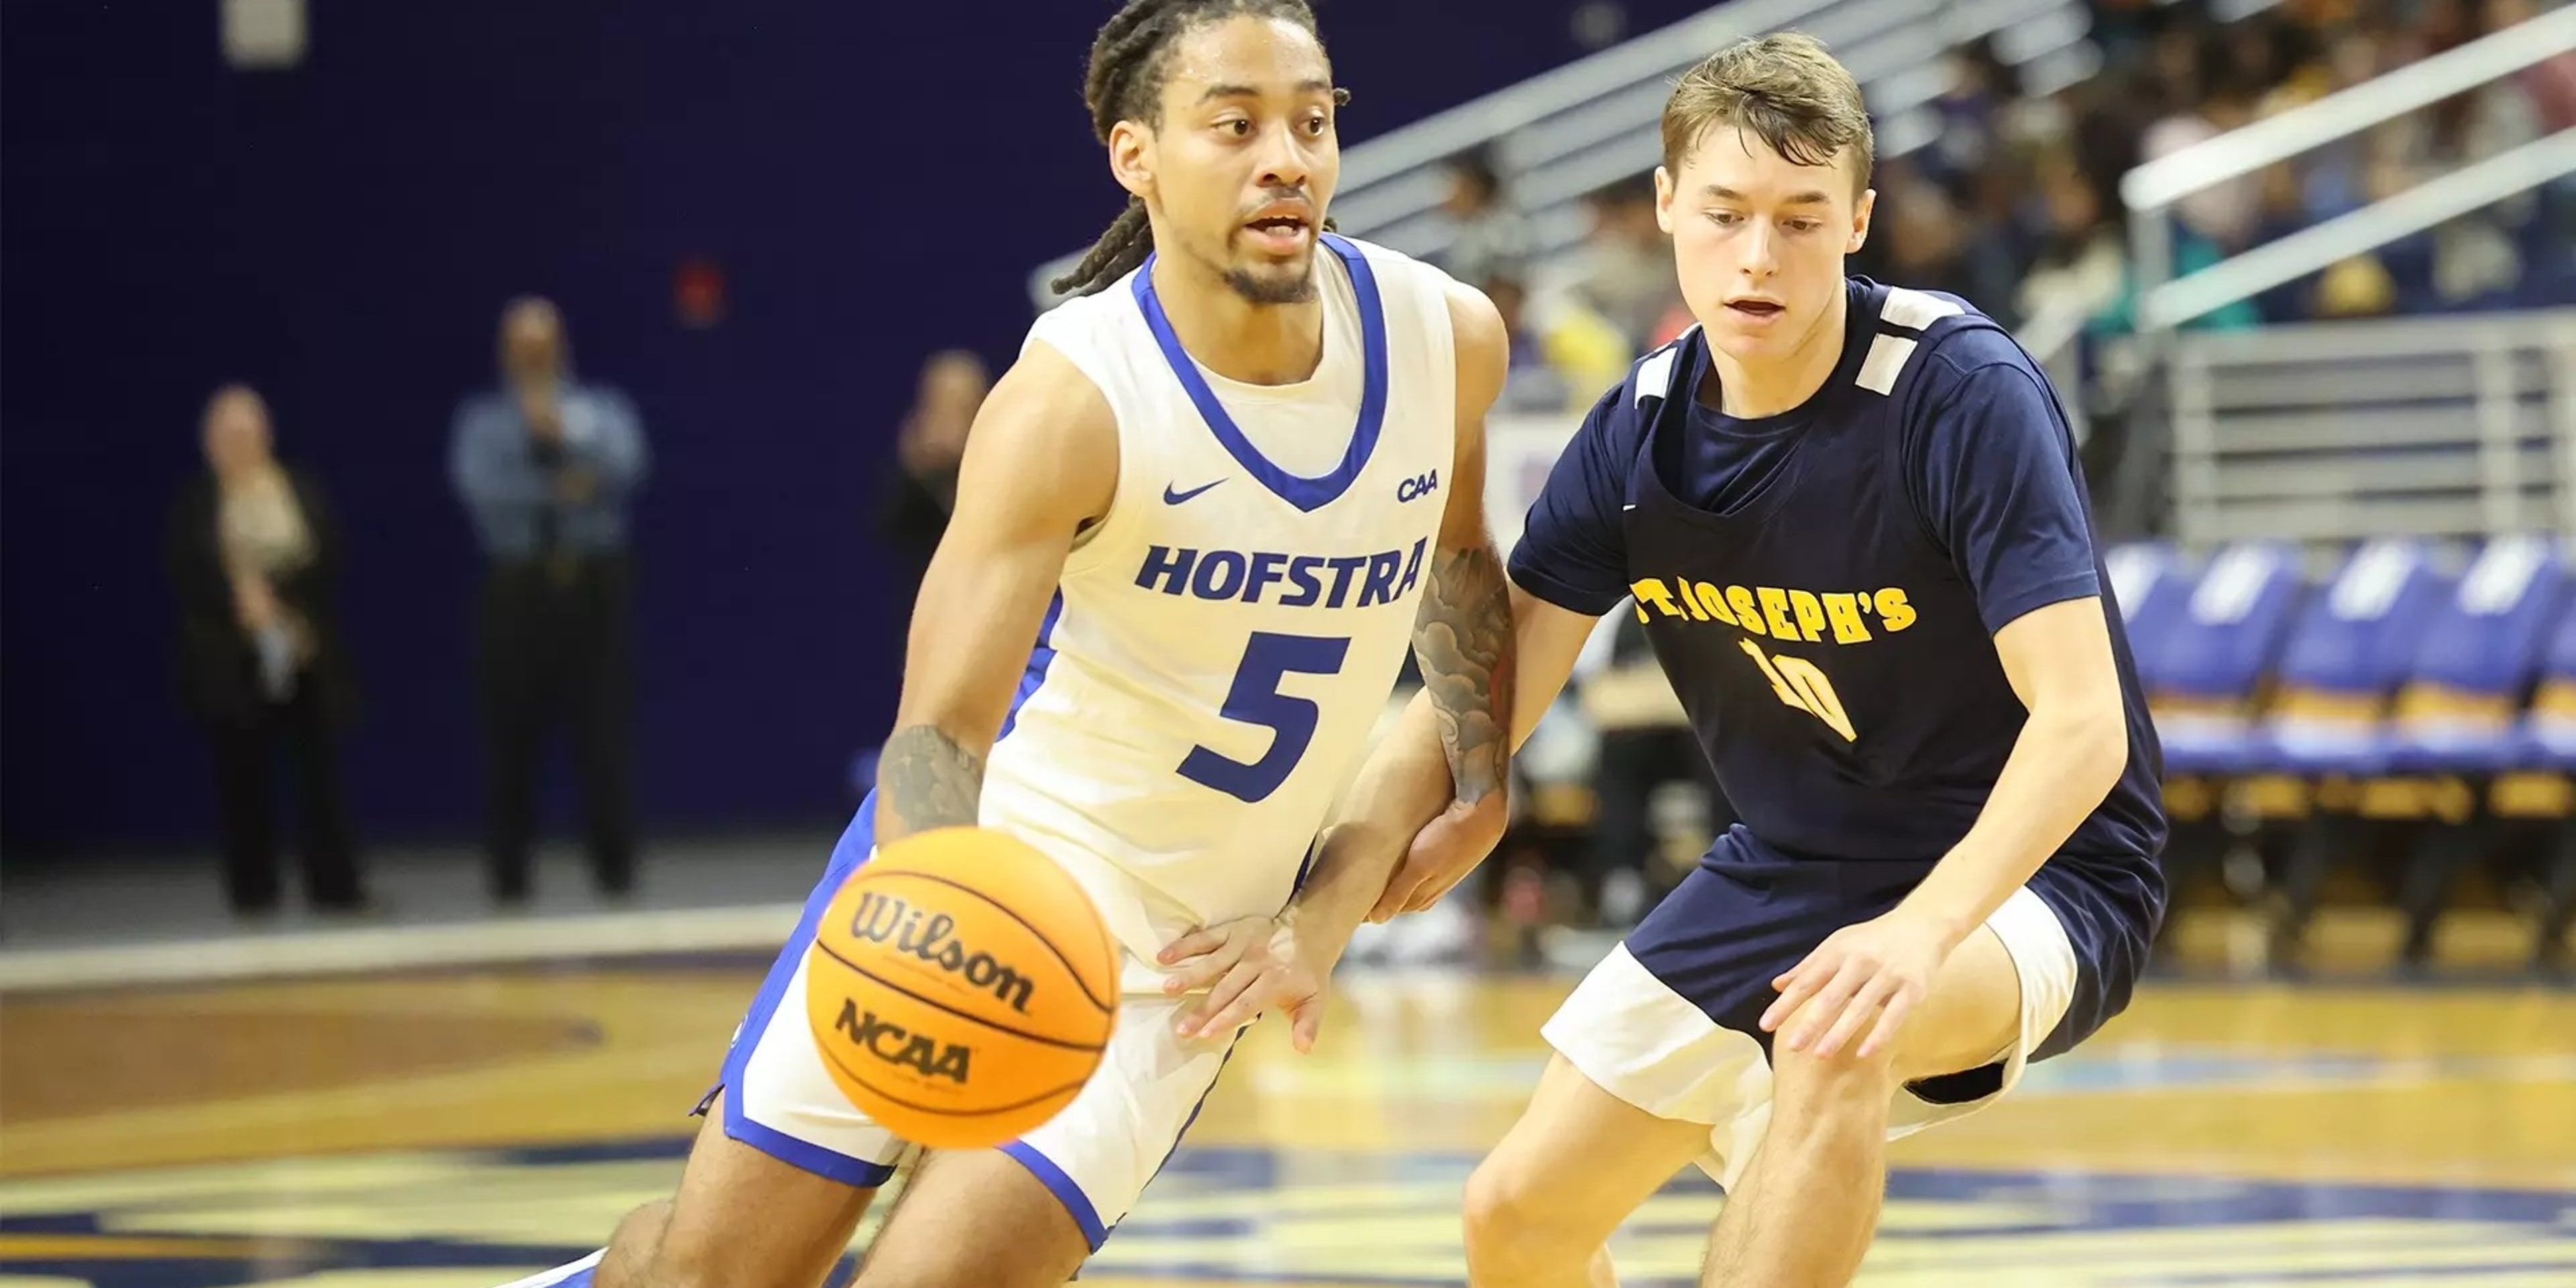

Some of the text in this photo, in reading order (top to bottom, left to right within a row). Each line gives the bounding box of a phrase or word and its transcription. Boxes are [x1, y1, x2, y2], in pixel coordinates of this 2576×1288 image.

[1397, 468, 1438, 503] CAA
[1134, 536, 1428, 608] HOFSTRA
[1677, 576, 1917, 645] JOSEPH'S
[1175, 631, 1352, 803] 5
[1738, 637, 1858, 743] 10
[851, 892, 1034, 1014] Wilson
[835, 997, 971, 1085] NCAA
